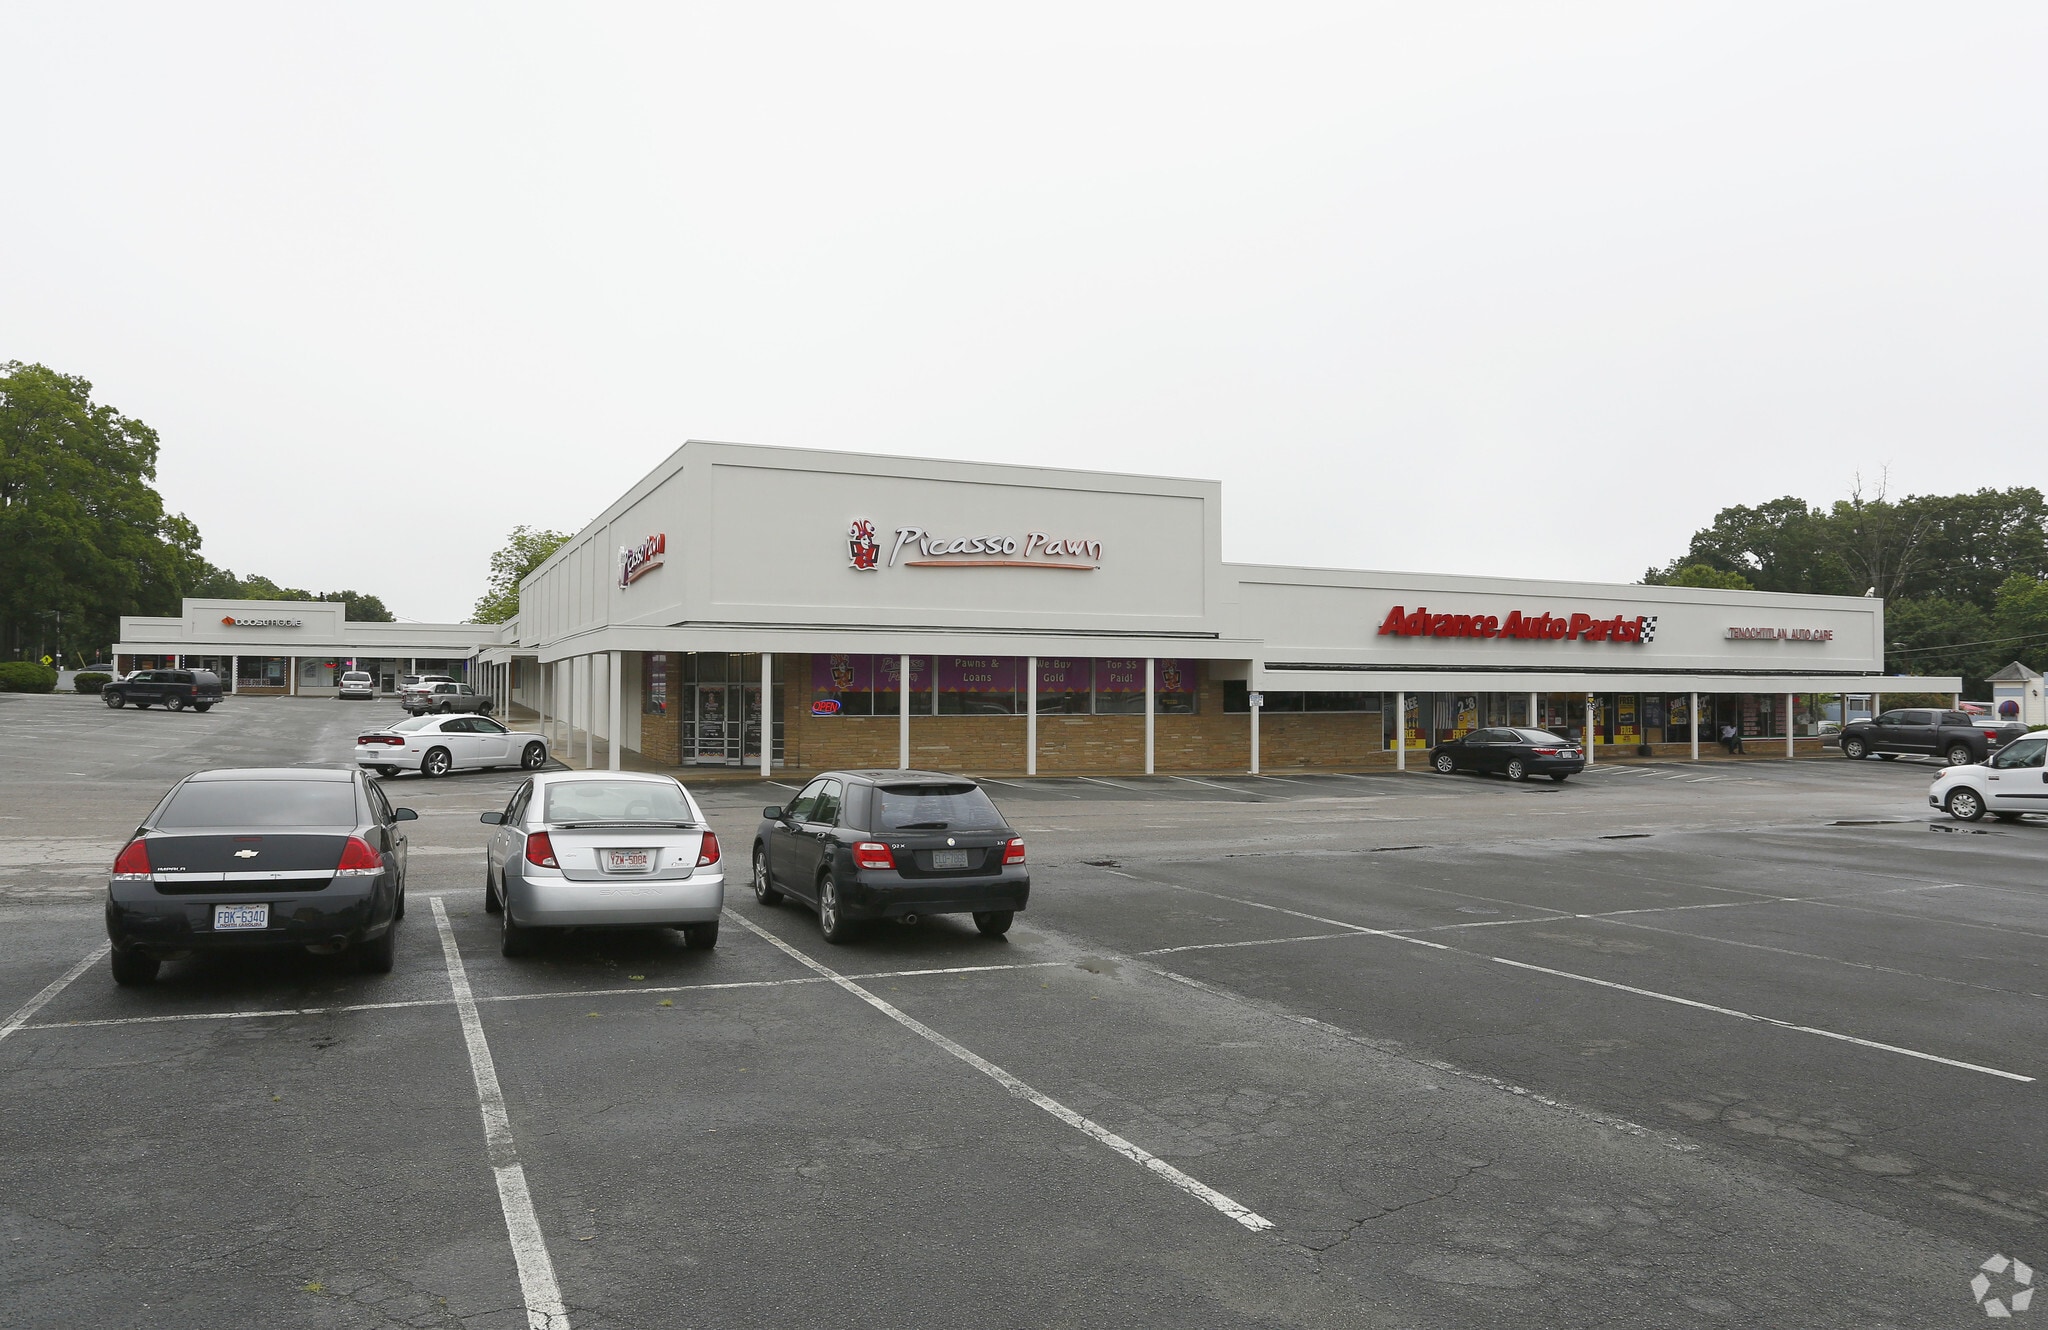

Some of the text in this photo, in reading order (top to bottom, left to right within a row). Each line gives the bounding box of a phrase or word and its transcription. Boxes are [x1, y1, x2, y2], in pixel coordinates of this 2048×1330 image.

[889, 527, 1102, 567] Picasso Pawn
[1378, 606, 1498, 638] Advance
[1499, 611, 1567, 639] Auto
[1791, 628, 1811, 640] AUTO
[1813, 630, 1833, 640] CARE
[955, 659, 999, 668] Pawns &
[1037, 659, 1072, 670] We Buy
[1106, 660, 1123, 670] Top
[963, 673, 992, 682] Loans
[1043, 673, 1064, 682] Gold
[1110, 673, 1133, 683] Paid!
[813, 701, 838, 712] OPEN
[600, 889, 664, 897] SATURN
[217, 910, 266, 924] FBK-6340
